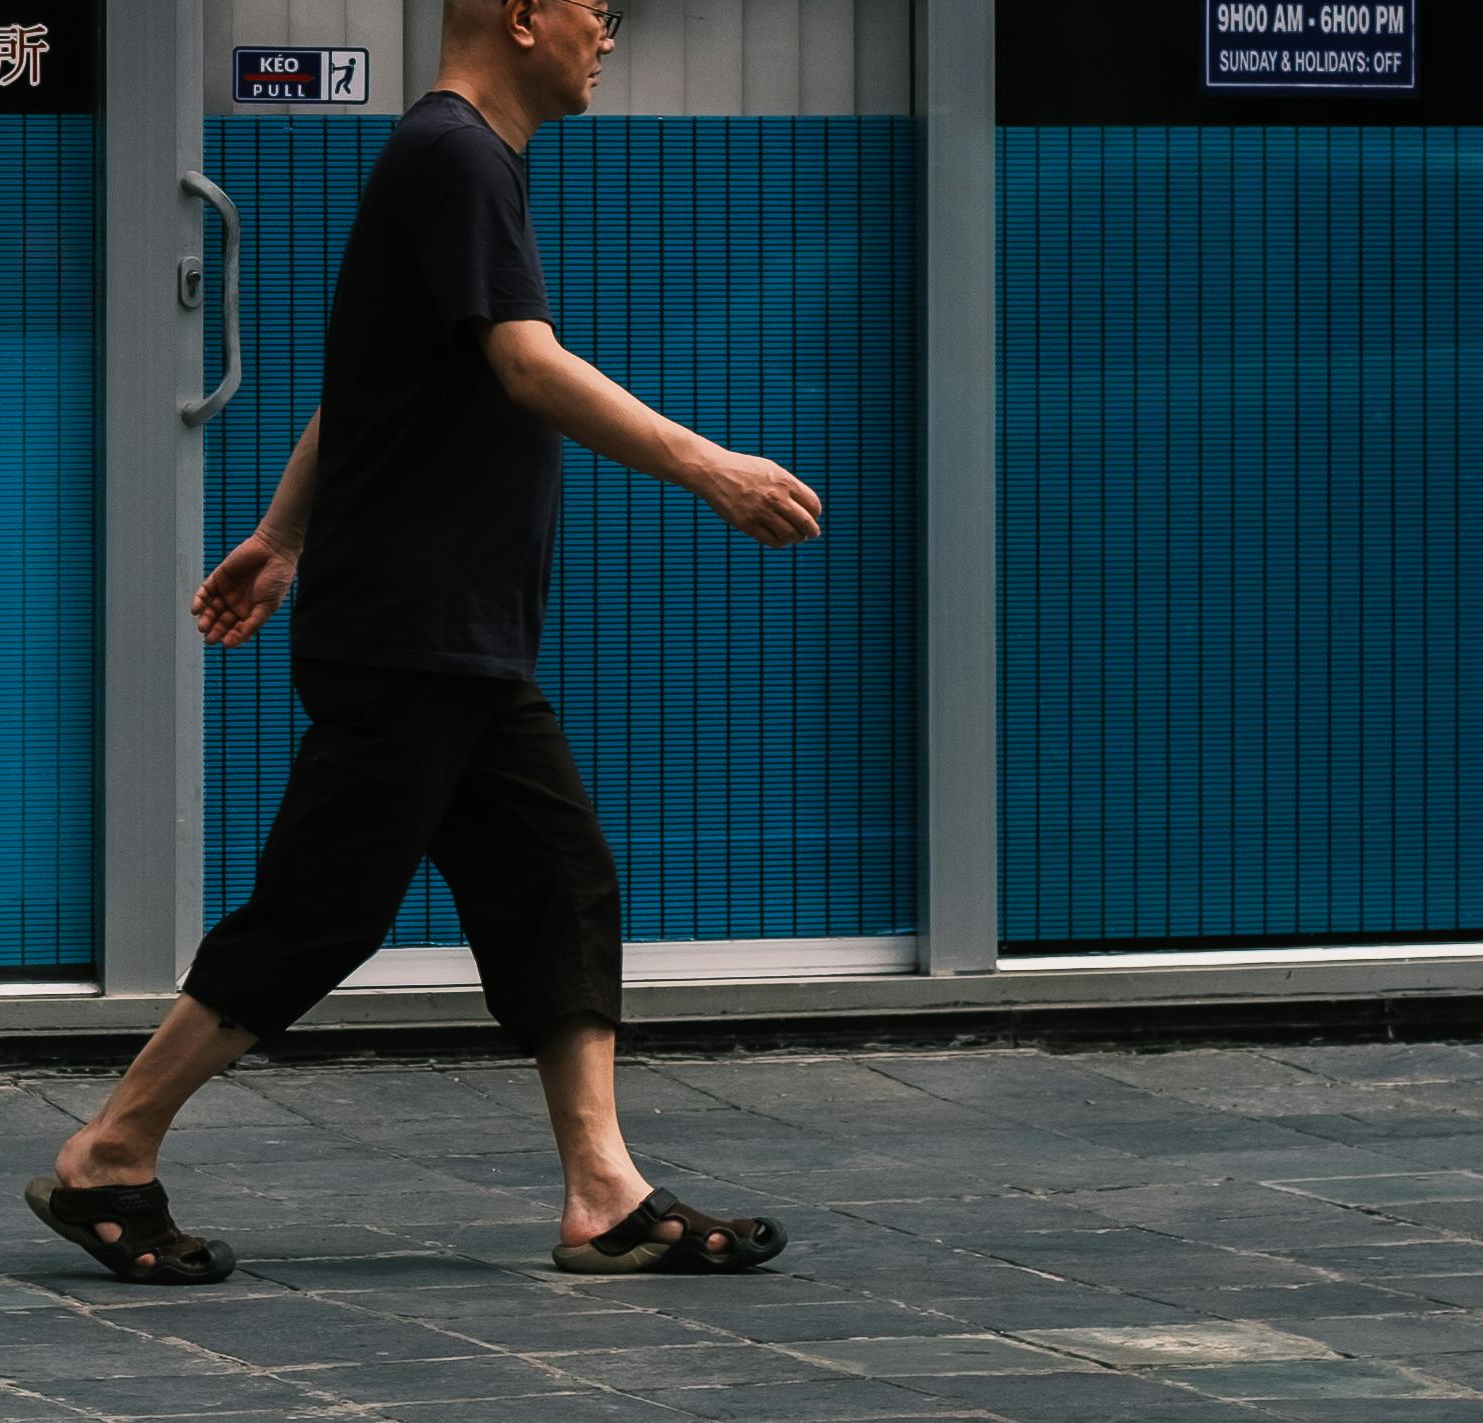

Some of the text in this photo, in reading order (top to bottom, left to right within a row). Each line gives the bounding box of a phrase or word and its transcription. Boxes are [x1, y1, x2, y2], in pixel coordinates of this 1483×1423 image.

[1218, 3, 1268, 32] 9H00
[1273, 4, 1303, 32] AM
[1320, 5, 1370, 34] 6H00
[1375, 5, 1404, 34] PM
[260, 54, 299, 73] KÉO
[1219, 49, 1402, 73] SUNDAY & HOLIDAYS: OFF
[253, 84, 316, 97] PULL
